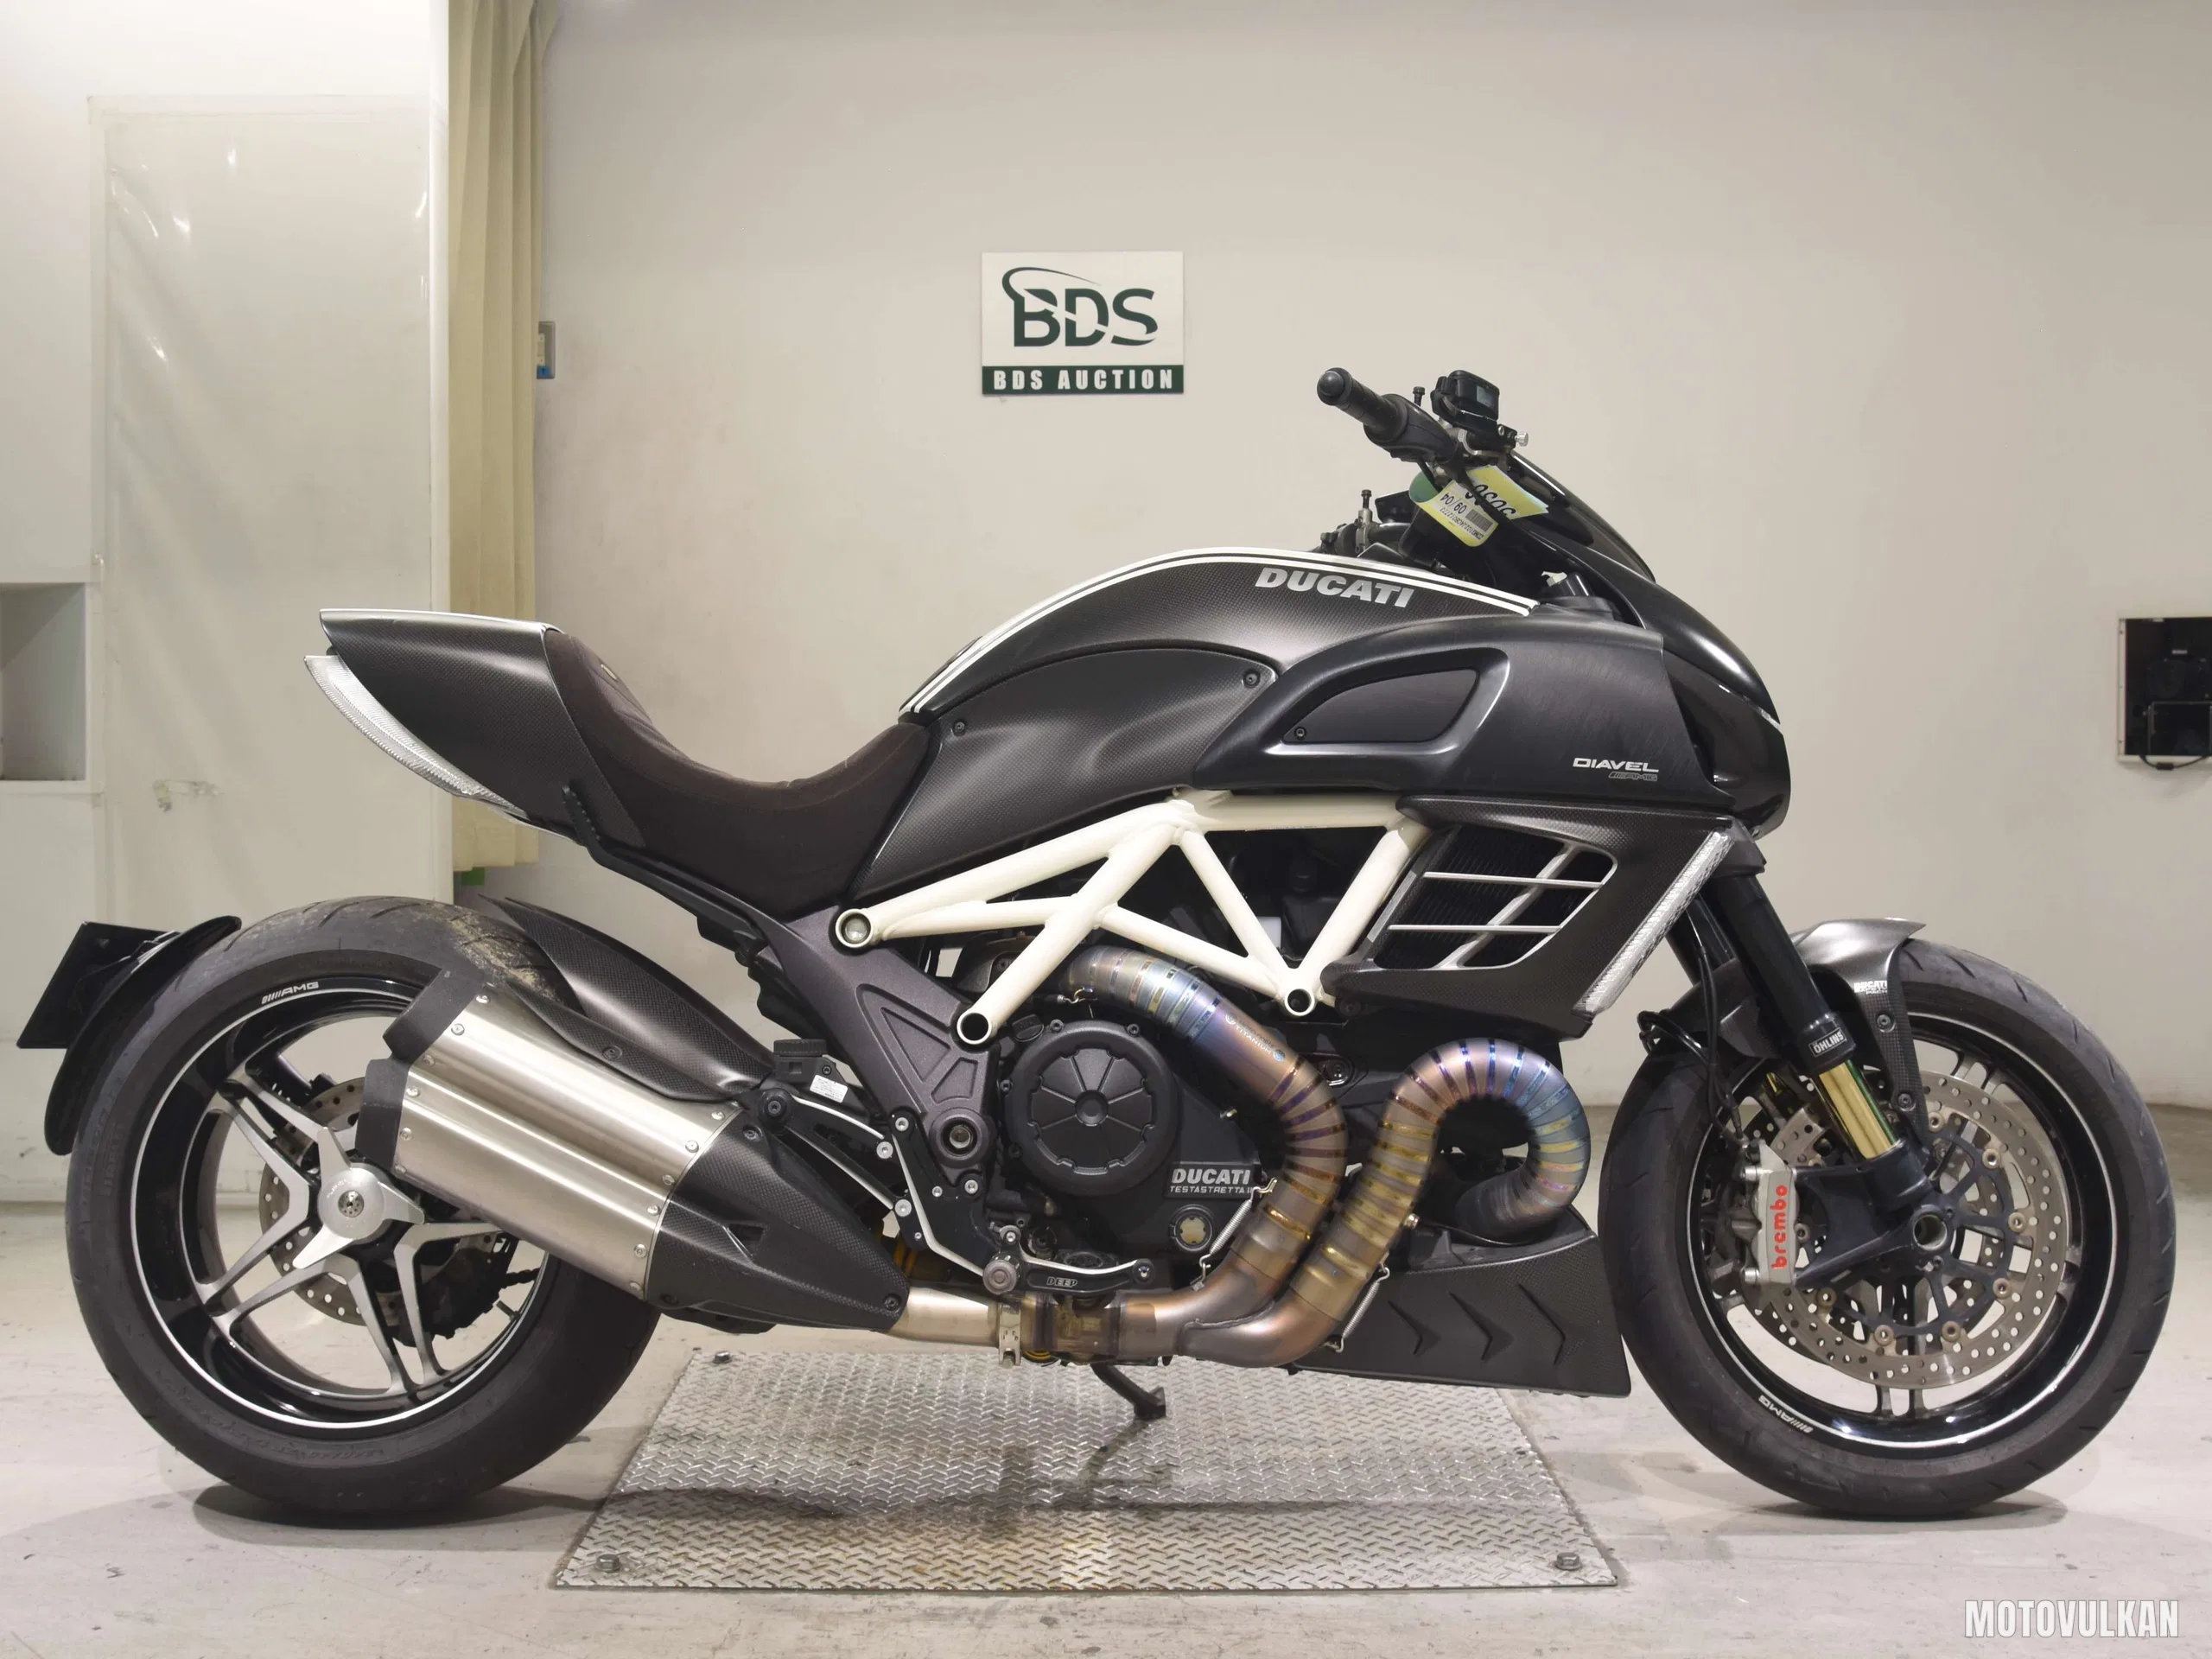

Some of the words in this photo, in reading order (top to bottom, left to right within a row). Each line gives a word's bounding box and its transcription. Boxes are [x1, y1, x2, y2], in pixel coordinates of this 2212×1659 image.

[1001, 266, 1159, 347] BDS
[994, 370, 1044, 391] BDS
[1058, 369, 1173, 390] AUCTION
[1255, 567, 1414, 608] DUCATI
[1573, 757, 1659, 772] DIAVEL
[1172, 1168, 1251, 1185] DUCATI
[1170, 1185, 1245, 1194] TESTASTRETTA
[1770, 1185, 1789, 1270] brembo
[1046, 1276, 1078, 1288] DEEP
